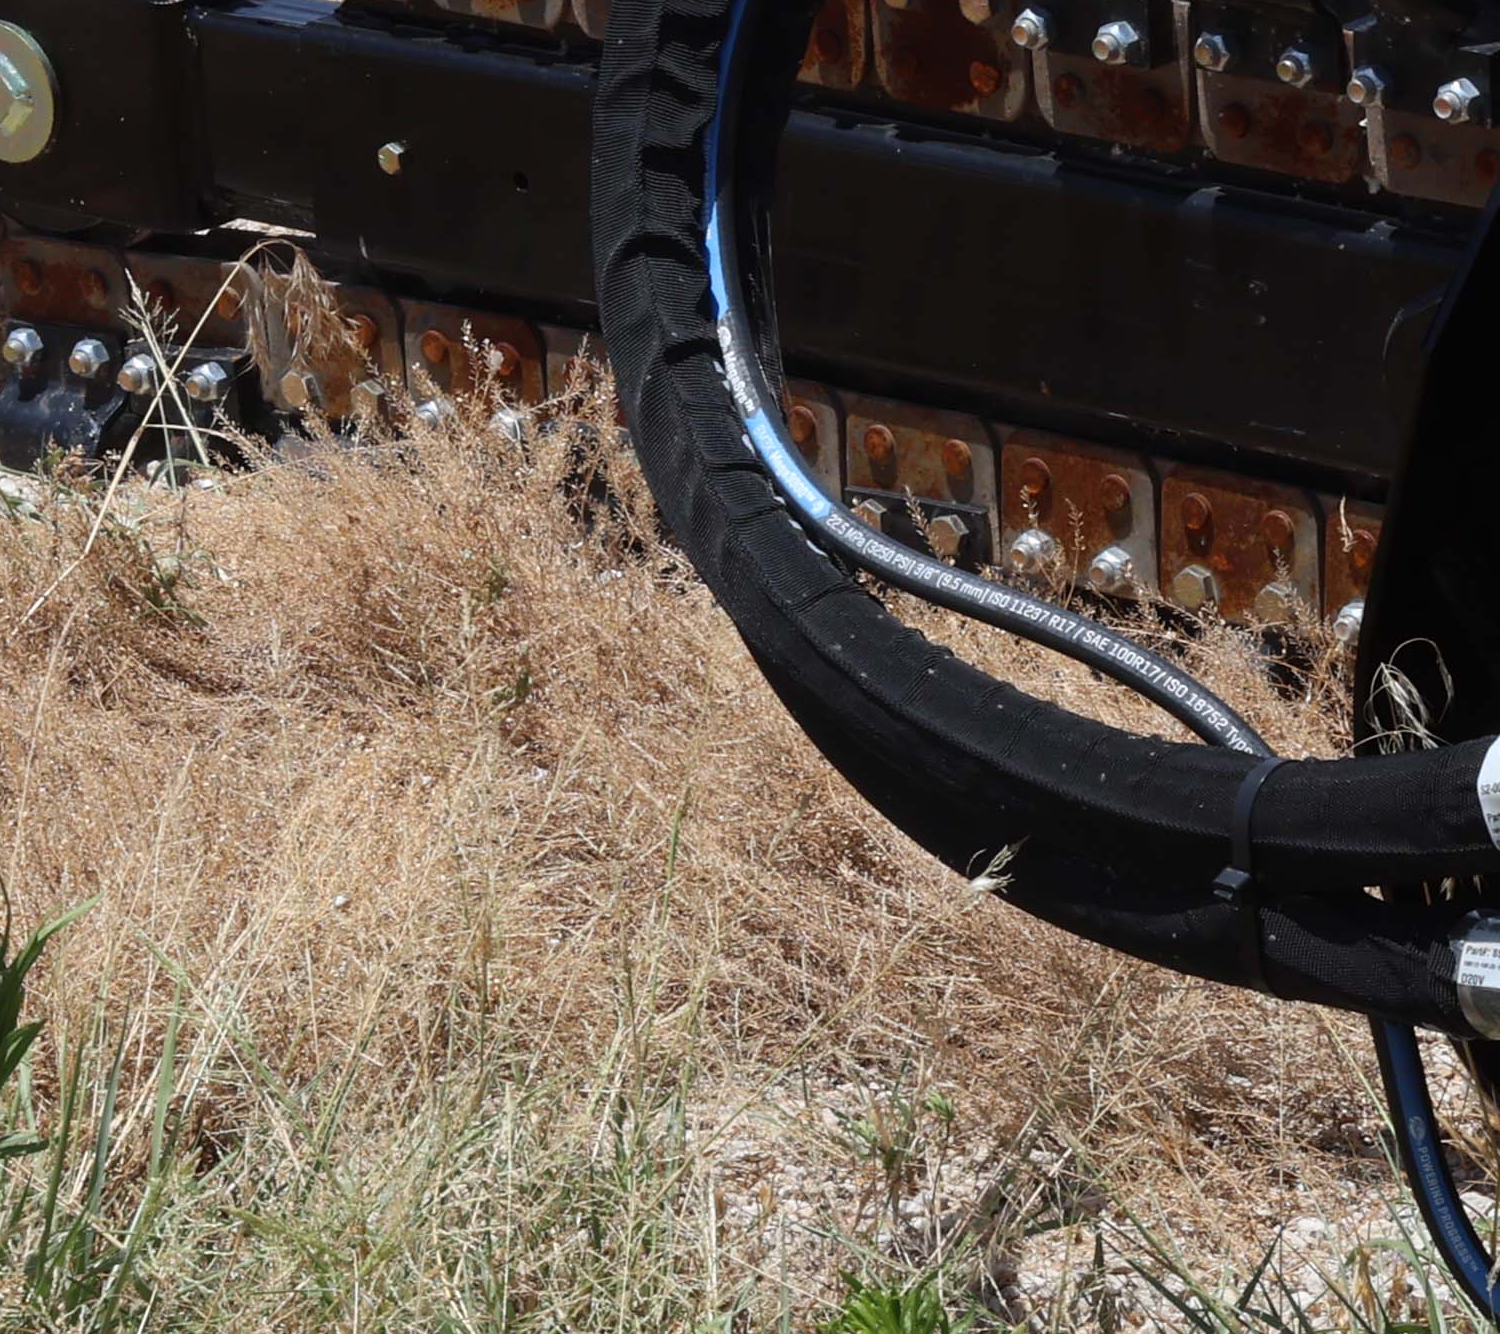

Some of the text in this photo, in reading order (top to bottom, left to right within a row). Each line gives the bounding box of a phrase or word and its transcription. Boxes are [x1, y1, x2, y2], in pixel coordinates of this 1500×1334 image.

[826, 514, 847, 536] 22.5
[844, 527, 865, 548] MPa
[987, 590, 1012, 609] ISO
[1011, 600, 1052, 624] 11237
[1048, 613, 1077, 634] R17
[1082, 630, 1112, 652] SAE
[1162, 675, 1190, 699] ISO
[1185, 690, 1231, 732] 18752
[1461, 973, 1485, 986] D20V
[1418, 1145, 1445, 1207] POWERING
